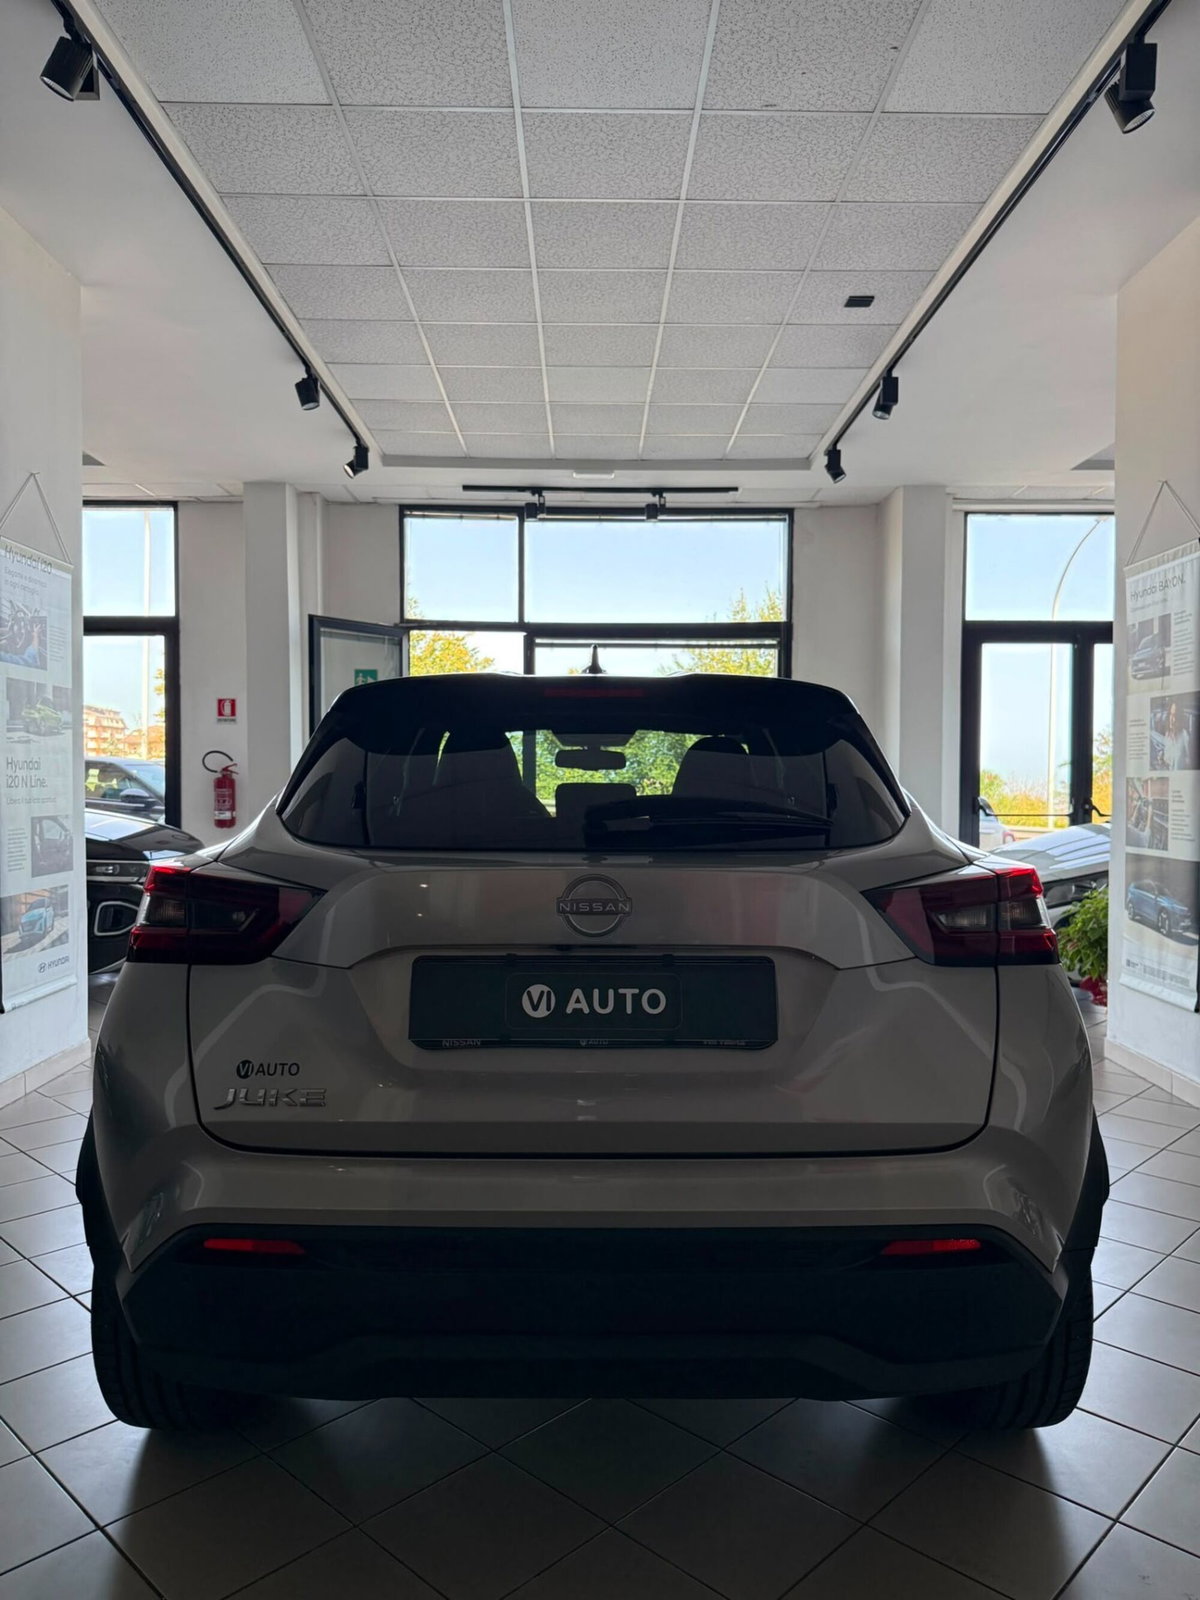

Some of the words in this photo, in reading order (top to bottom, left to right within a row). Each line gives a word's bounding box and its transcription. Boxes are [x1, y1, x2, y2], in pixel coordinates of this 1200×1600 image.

[1130, 587, 1157, 602] Hyundai
[6, 756, 41, 773] Hyundai
[6, 774, 20, 789] i20
[21, 775, 28, 788] N
[559, 902, 631, 912] NISSAN
[566, 988, 667, 1015] AUTO
[442, 1039, 481, 1047] NISSAN
[255, 1062, 300, 1076] AUTO
[213, 1088, 327, 1110] JUKE
